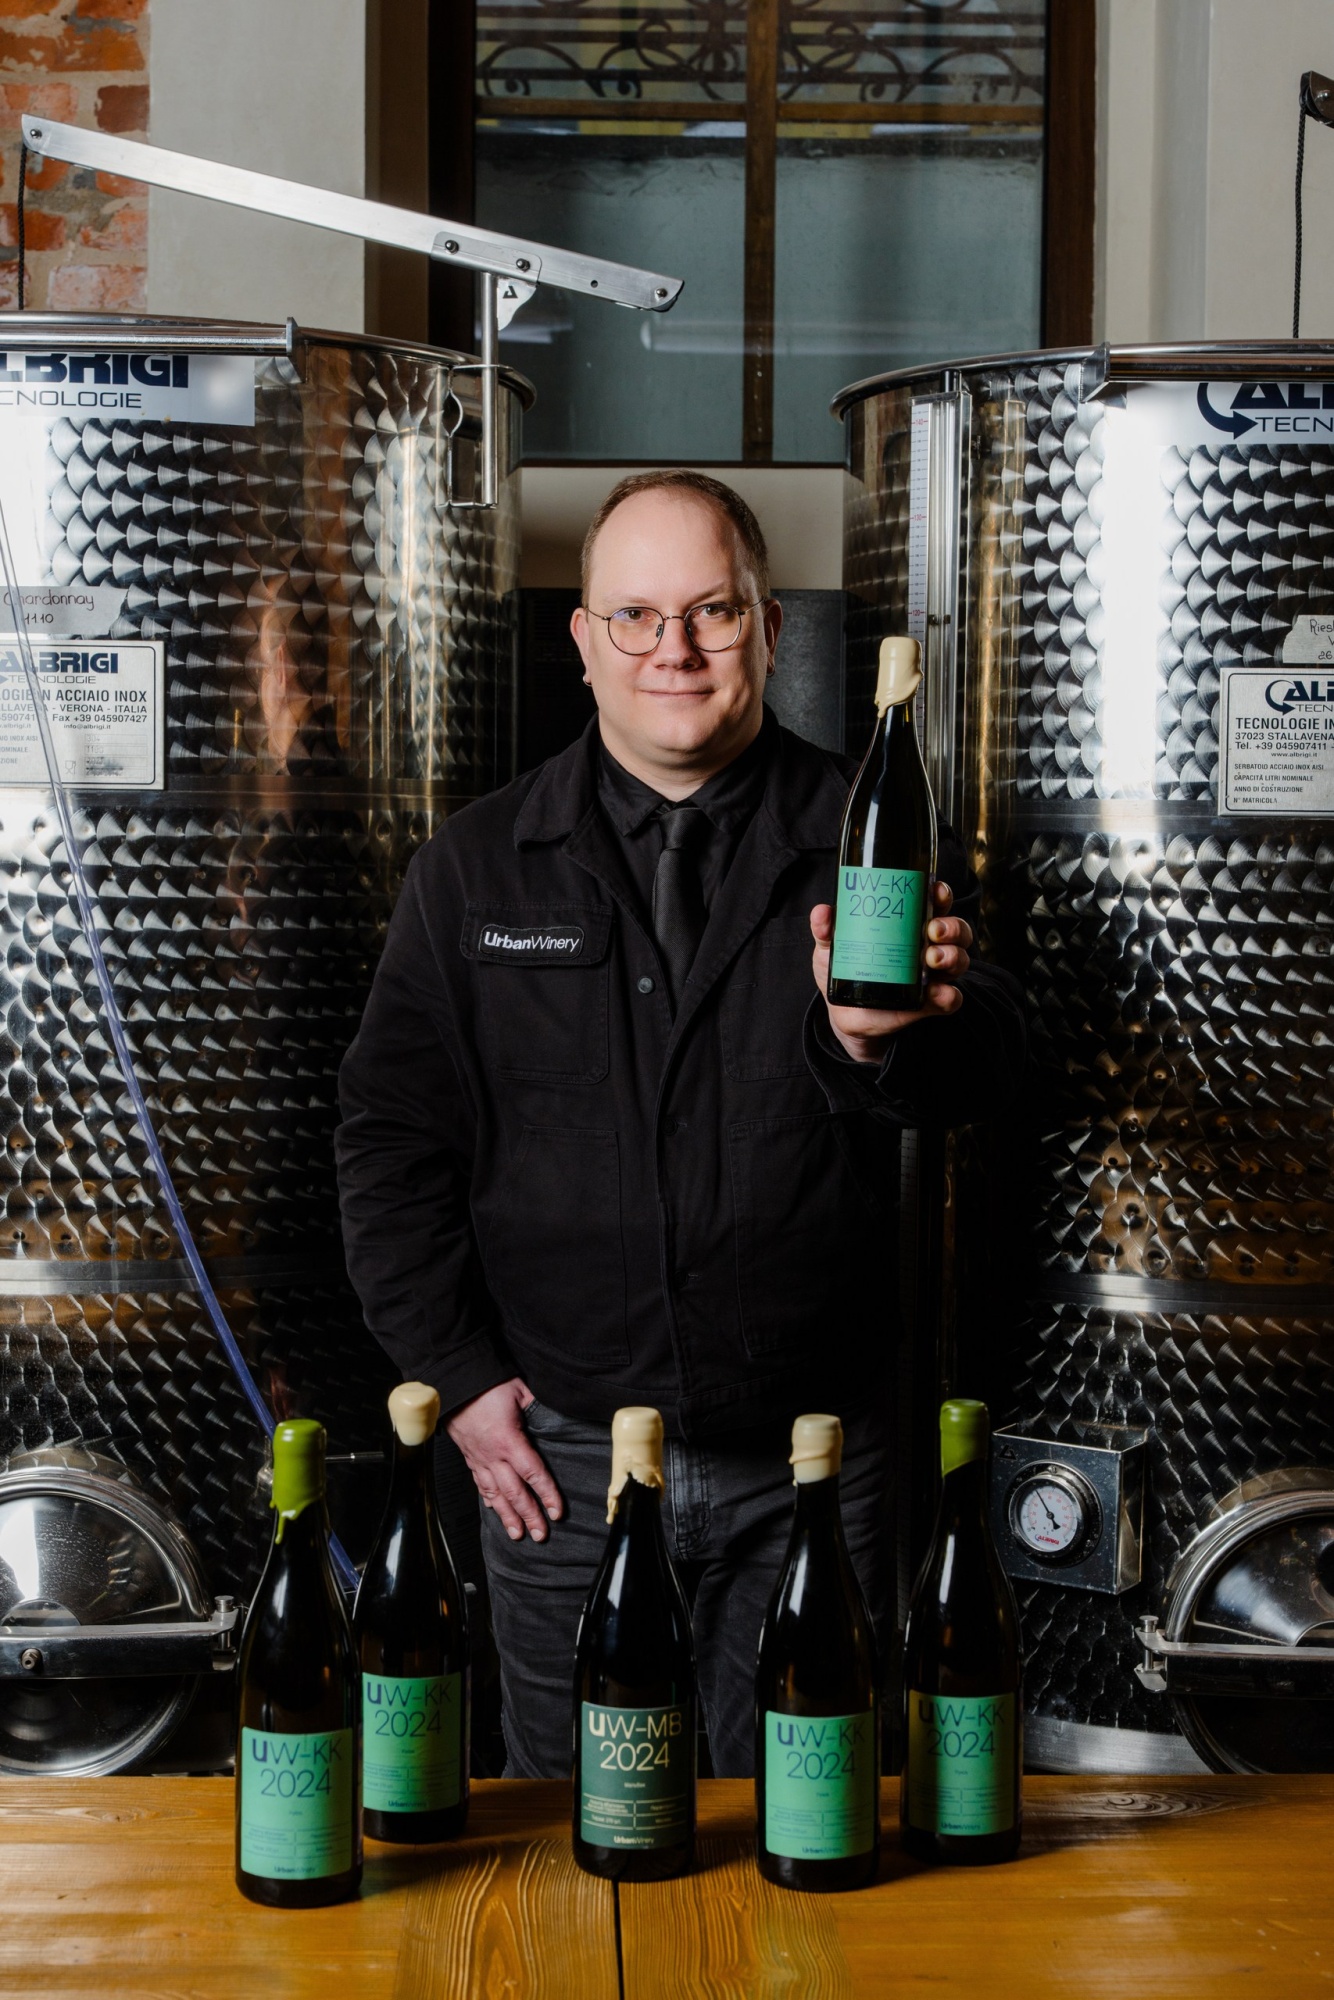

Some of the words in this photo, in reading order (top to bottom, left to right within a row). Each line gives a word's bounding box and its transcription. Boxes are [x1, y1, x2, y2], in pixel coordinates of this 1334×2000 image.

[1230, 383, 1334, 410] AL
[1255, 416, 1334, 432] TECN
[8, 675, 97, 684] TENOLOGIE
[55, 689, 110, 702] ACCIAIO
[114, 690, 148, 702] INOX
[60, 704, 103, 713] VERONA
[114, 705, 148, 713] ITALIA
[1295, 703, 1334, 713] TECN
[52, 713, 70, 722] Fax
[74, 713, 92, 722] +39
[94, 714, 148, 723] 045907427
[1235, 717, 1320, 730] TECNOLOGIE
[64, 723, 111, 731] info@albrigi.it
[1235, 731, 1265, 740] 37023
[1267, 732, 1334, 741] STALLAVENA
[1235, 741, 1252, 750] Tel.
[1255, 741, 1273, 750] +39
[1275, 742, 1327, 750] 045907411
[849, 894, 905, 919] 2024
[484, 931, 580, 953] UrbanWinery
[375, 1709, 443, 1738] 2024
[927, 1729, 996, 1758] 2024
[600, 1740, 670, 1772] 2024
[786, 1751, 856, 1780] 2024
[260, 1767, 333, 1798] 2024
